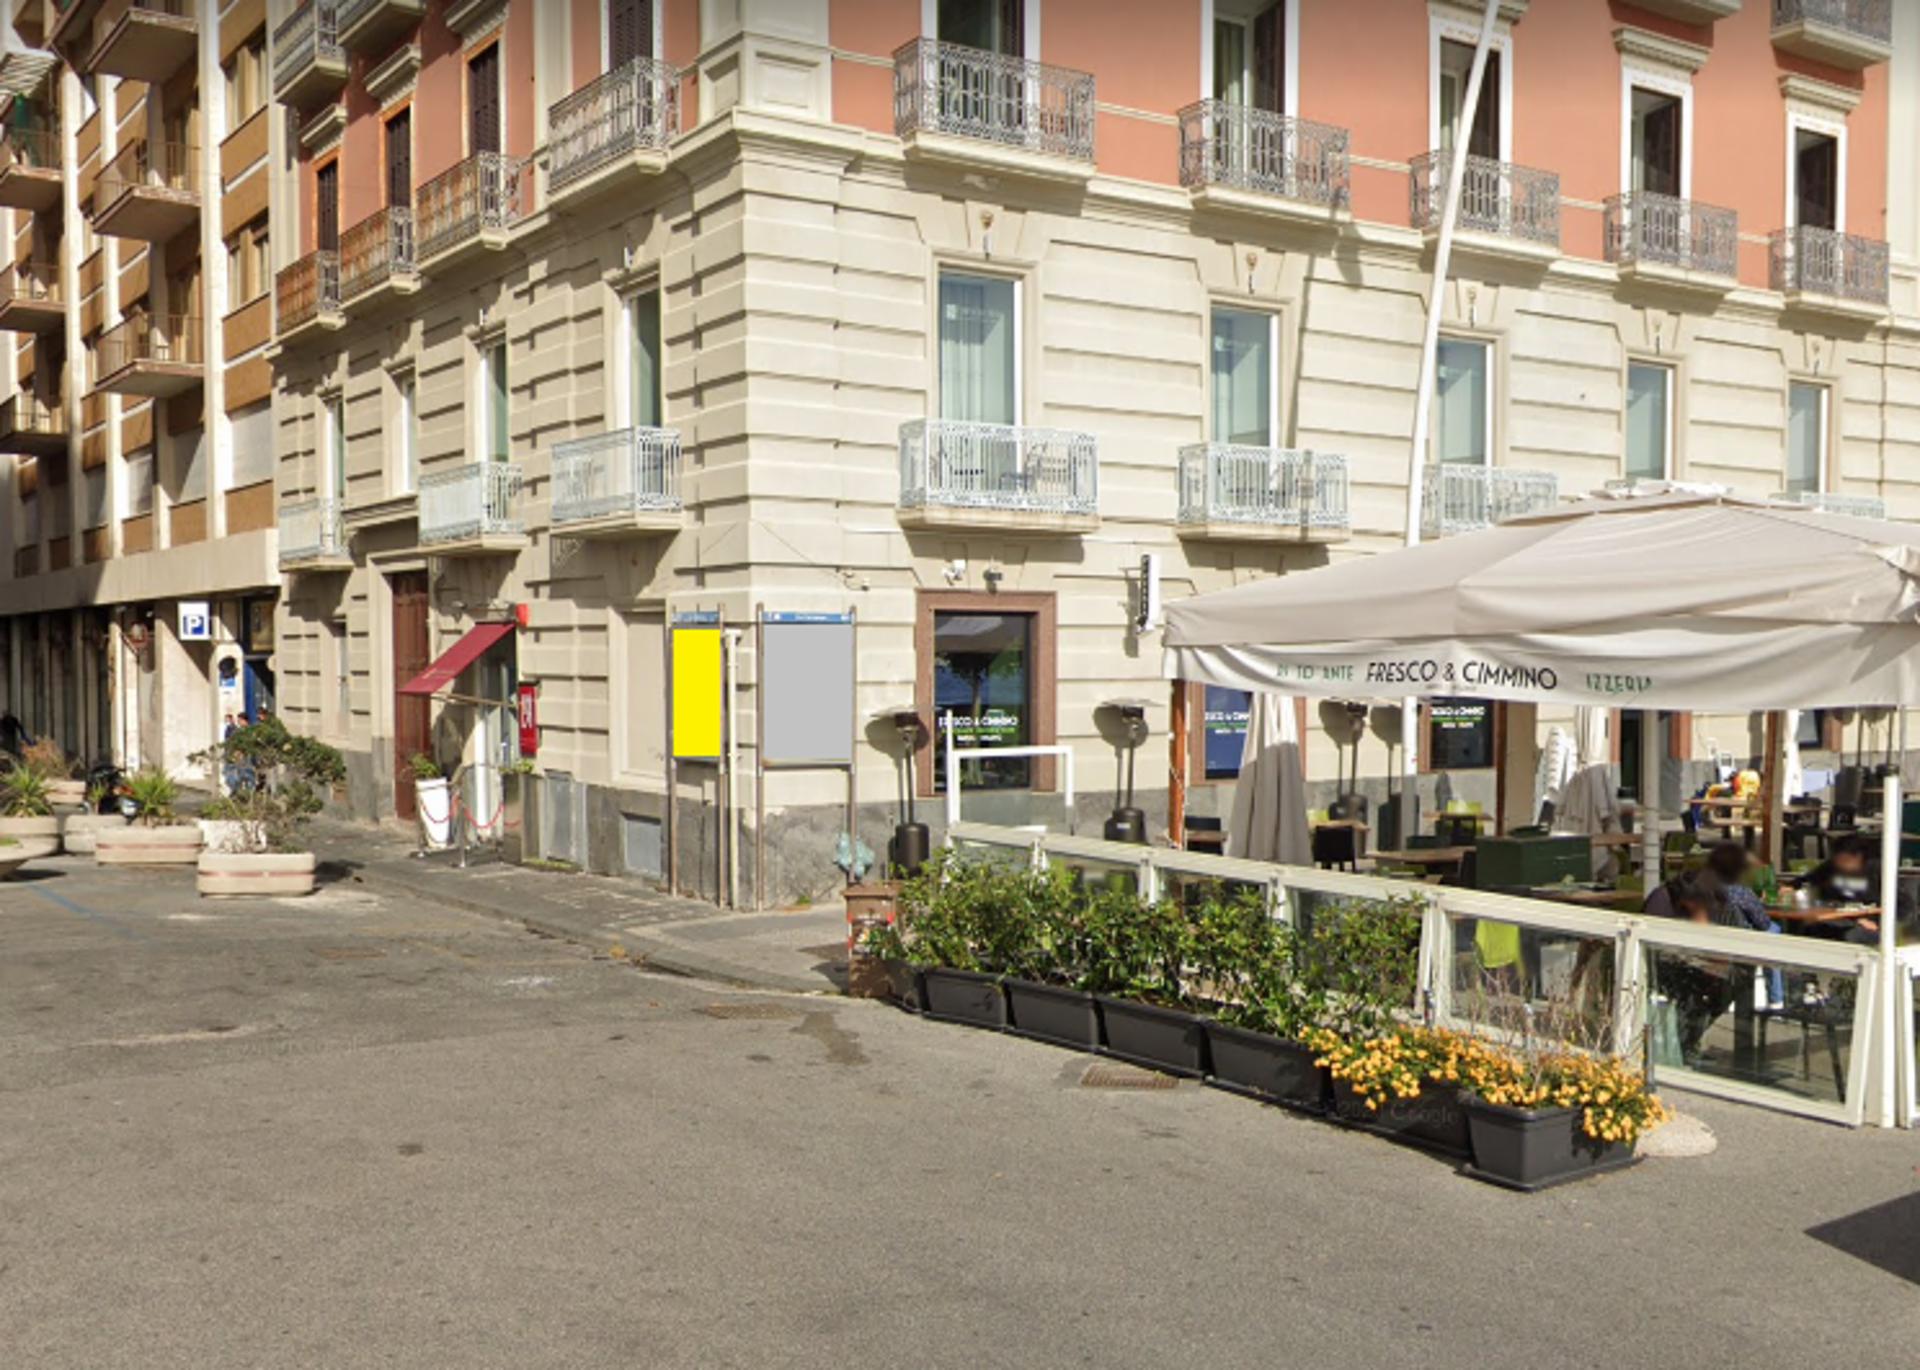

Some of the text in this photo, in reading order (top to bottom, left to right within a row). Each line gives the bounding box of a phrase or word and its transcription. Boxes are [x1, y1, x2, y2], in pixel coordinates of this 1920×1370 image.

[1367, 660, 1438, 682] FRESCO
[1443, 662, 1456, 682] &
[1463, 661, 1558, 690] CIMMINO
